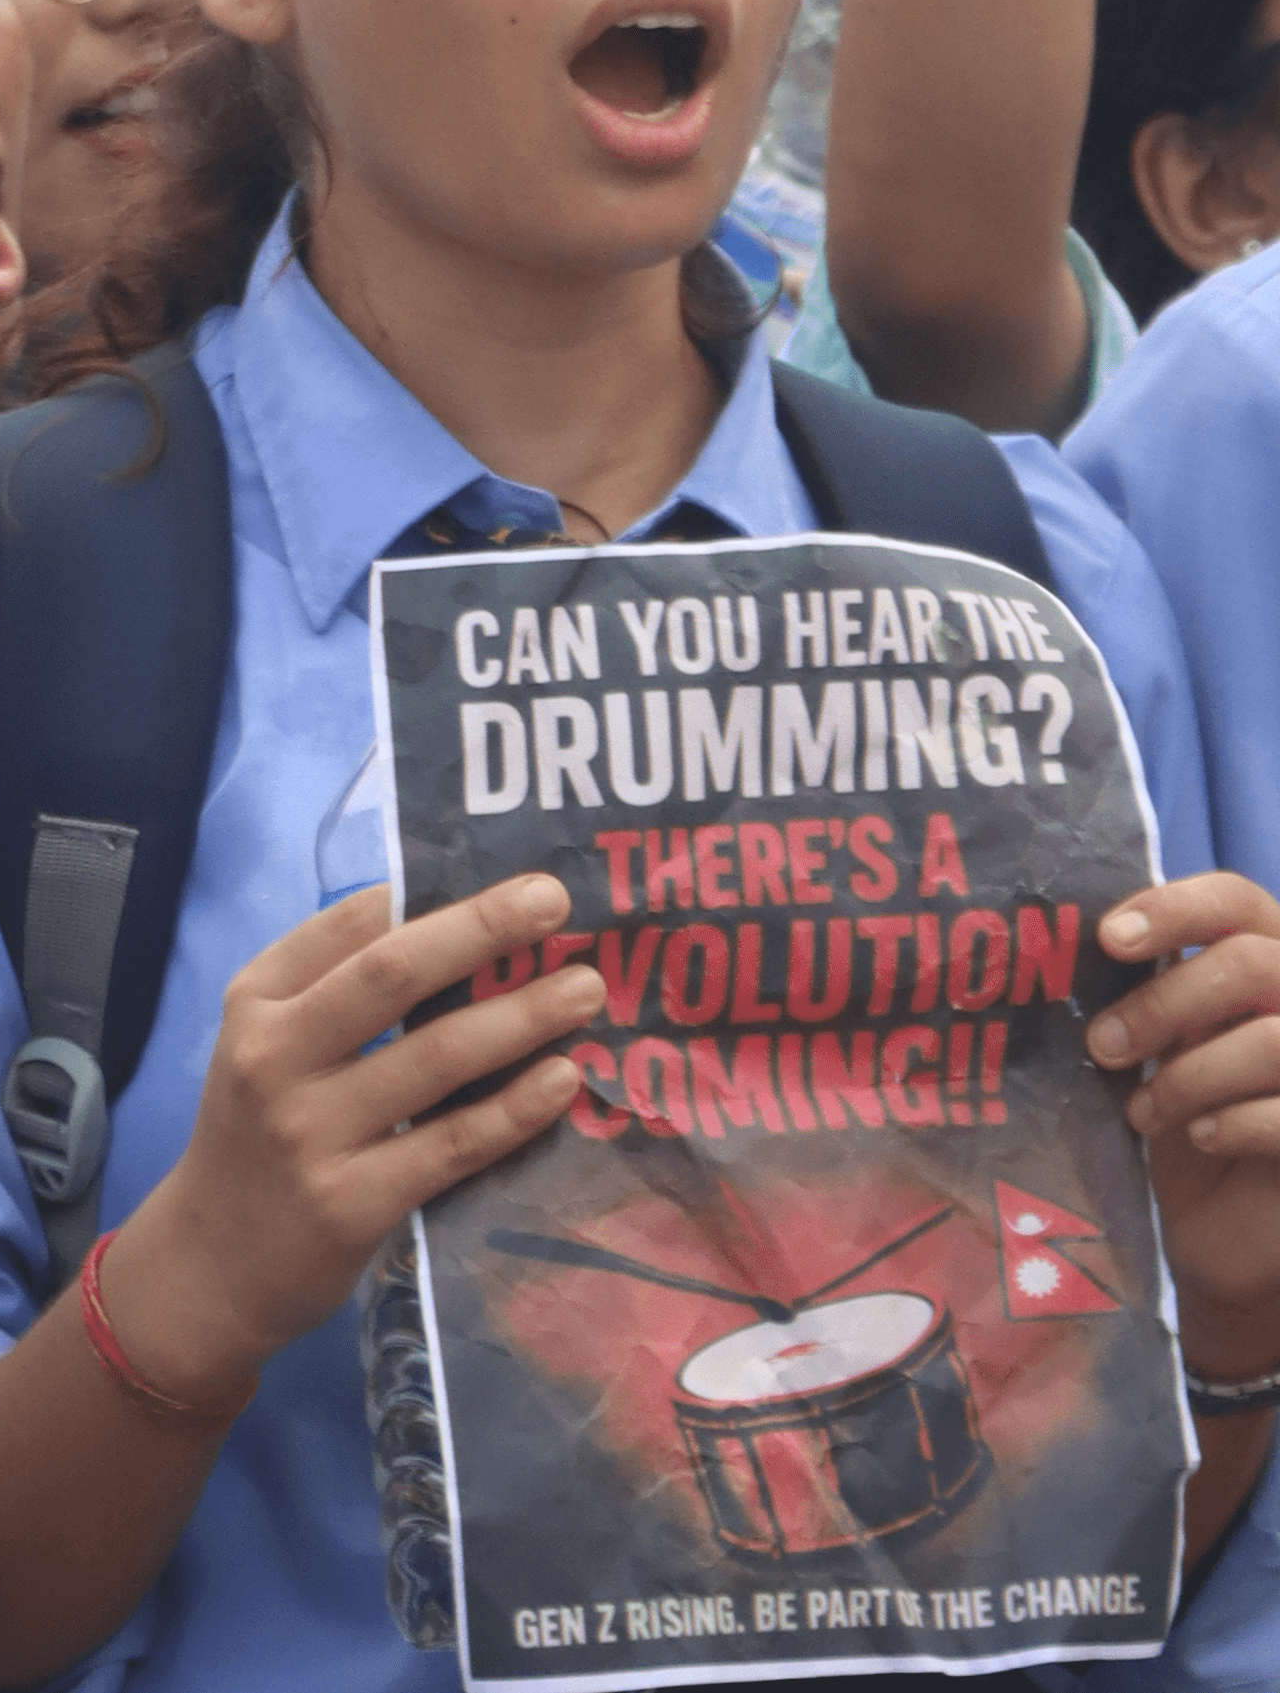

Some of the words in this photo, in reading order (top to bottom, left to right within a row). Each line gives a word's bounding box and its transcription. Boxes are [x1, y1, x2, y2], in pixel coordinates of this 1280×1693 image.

[455, 605, 599, 689] CAN
[621, 596, 759, 677] YOU
[785, 589, 946, 667] HEAR
[954, 587, 1064, 664] THE
[462, 675, 1074, 816] DRUMMING?
[595, 815, 898, 915] THERE'S
[920, 813, 970, 897] A
[567, 1024, 1008, 1141] COMING!!
[514, 1605, 586, 1649] GEN
[595, 1602, 617, 1643] Z
[624, 1595, 744, 1641] RISING.
[753, 1592, 798, 1632] BE
[805, 1588, 891, 1629] PART
[929, 1588, 995, 1629] THE
[1003, 1574, 1145, 1622] CHANGE.
